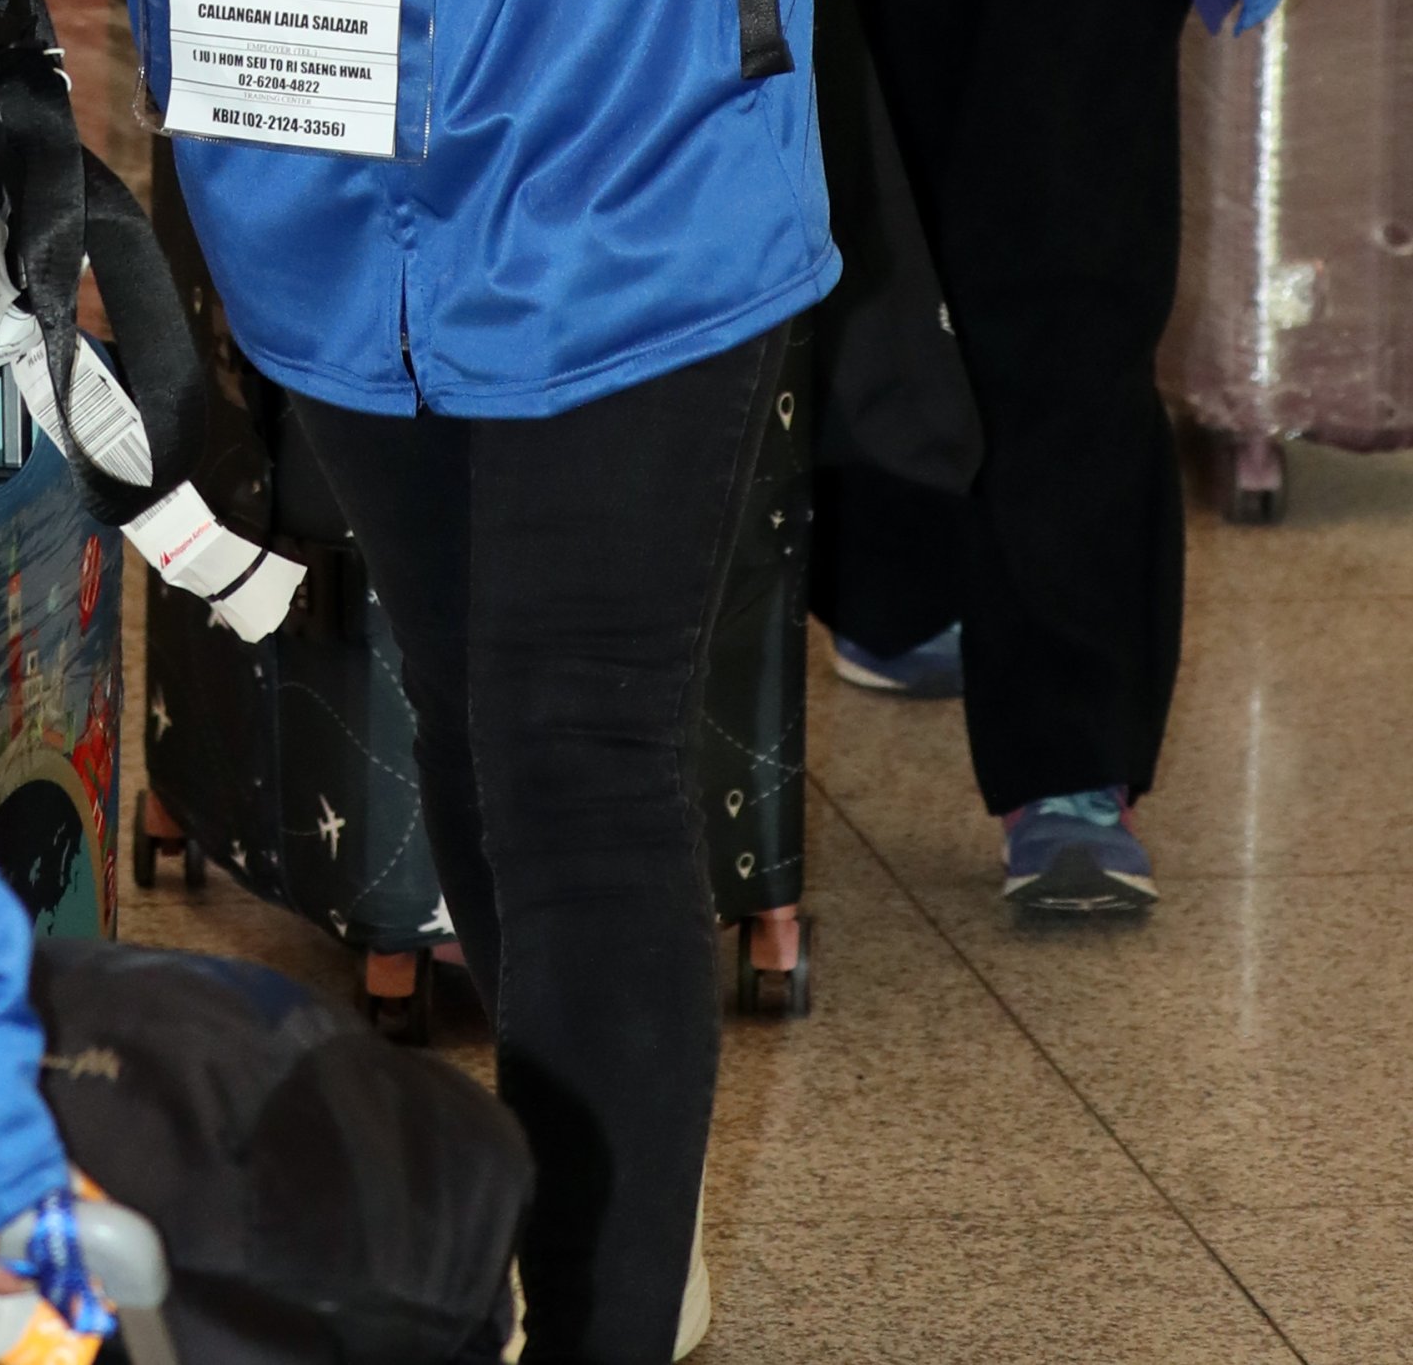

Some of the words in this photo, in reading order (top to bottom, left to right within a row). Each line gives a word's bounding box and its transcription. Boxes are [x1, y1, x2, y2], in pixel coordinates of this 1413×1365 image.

[198, 3, 271, 25] CALLANGAN
[274, 11, 309, 29] LAILA
[312, 15, 368, 35] SALAZAR
[246, 42, 292, 56] EMPLOYER
[219, 52, 244, 68] HOM
[246, 56, 268, 70] SEU
[270, 58, 283, 71] TO
[287, 59, 297, 73] RI
[300, 61, 337, 77] SAENG
[339, 65, 373, 80] HWAL
[238, 73, 320, 94] 02-6204-4822
[243, 91, 280, 102] TRAINING
[281, 96, 312, 106] CENTER
[212, 107, 240, 126] KBIZ
[242, 111, 346, 137] (02-2124-3356)
